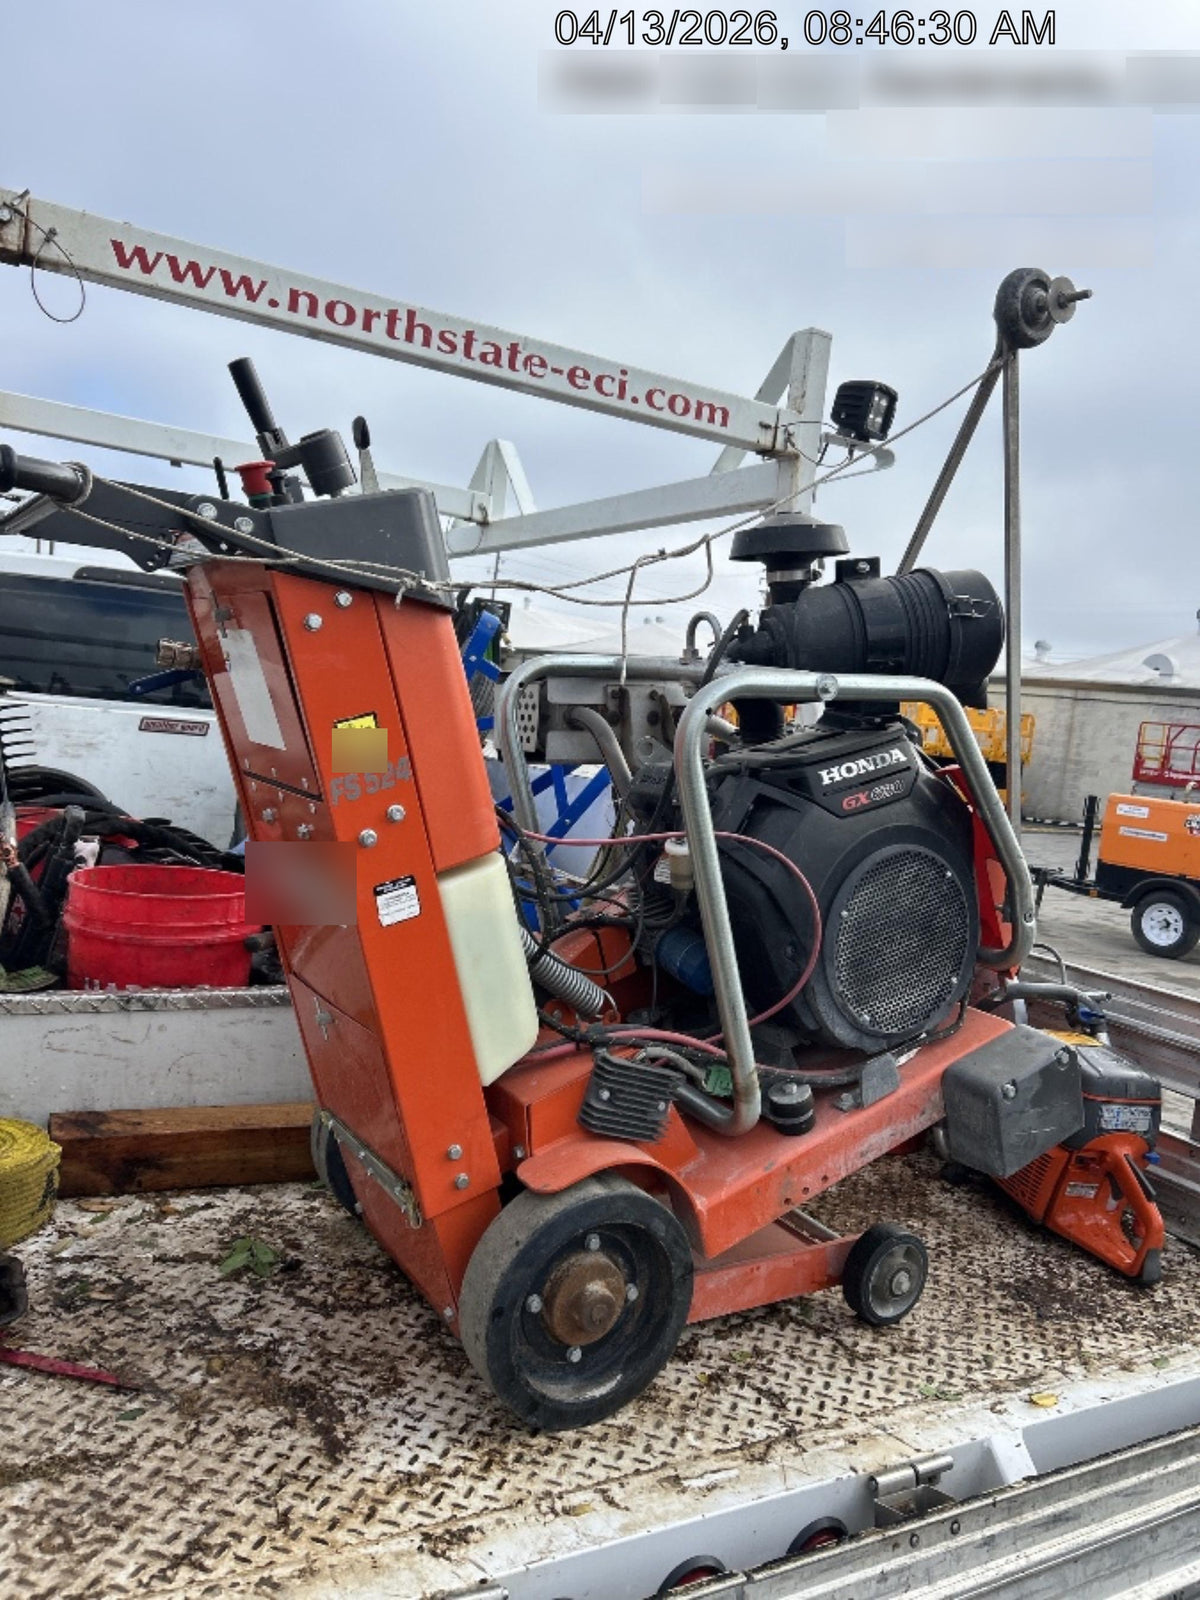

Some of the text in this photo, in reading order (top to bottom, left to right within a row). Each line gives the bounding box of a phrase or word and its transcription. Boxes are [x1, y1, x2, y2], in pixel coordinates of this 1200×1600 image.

[109, 238, 730, 428] www.northstate-eci.com
[818, 747, 908, 785] HONDA
[330, 772, 362, 806] FS
